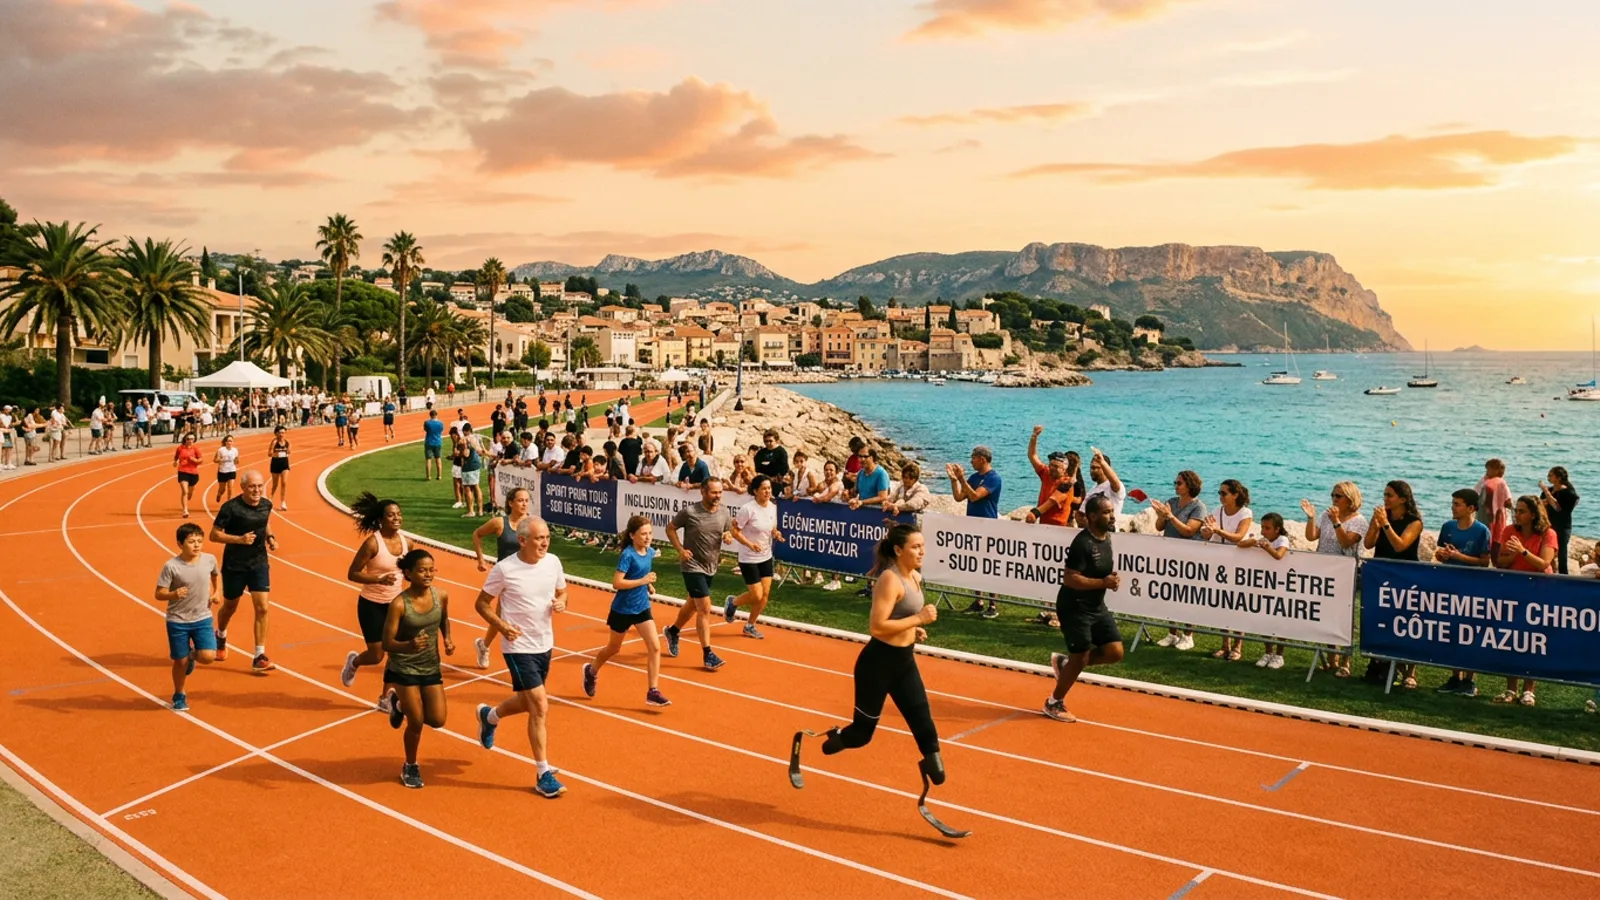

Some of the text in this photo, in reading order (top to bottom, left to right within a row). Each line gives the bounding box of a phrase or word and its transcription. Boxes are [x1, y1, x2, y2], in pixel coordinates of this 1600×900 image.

[589, 489, 608, 505] TOUS
[818, 538, 858, 558] D'AZUR
[936, 530, 982, 550] SPORT
[986, 537, 1027, 558] POUR
[949, 553, 977, 573] SUD
[983, 558, 1001, 577] DE
[1006, 561, 1065, 586] FRANCE
[1117, 553, 1209, 582] INCLUSION
[1215, 565, 1228, 584] &
[1234, 568, 1336, 598] BIEN-ÊTRE
[1130, 578, 1321, 622] & COMMUNAUTAIRE
[1378, 581, 1600, 633] ÉVÉNEMENT CHRO
[1393, 613, 1451, 643] CÔTE
[1458, 623, 1547, 656] D'AZUR
